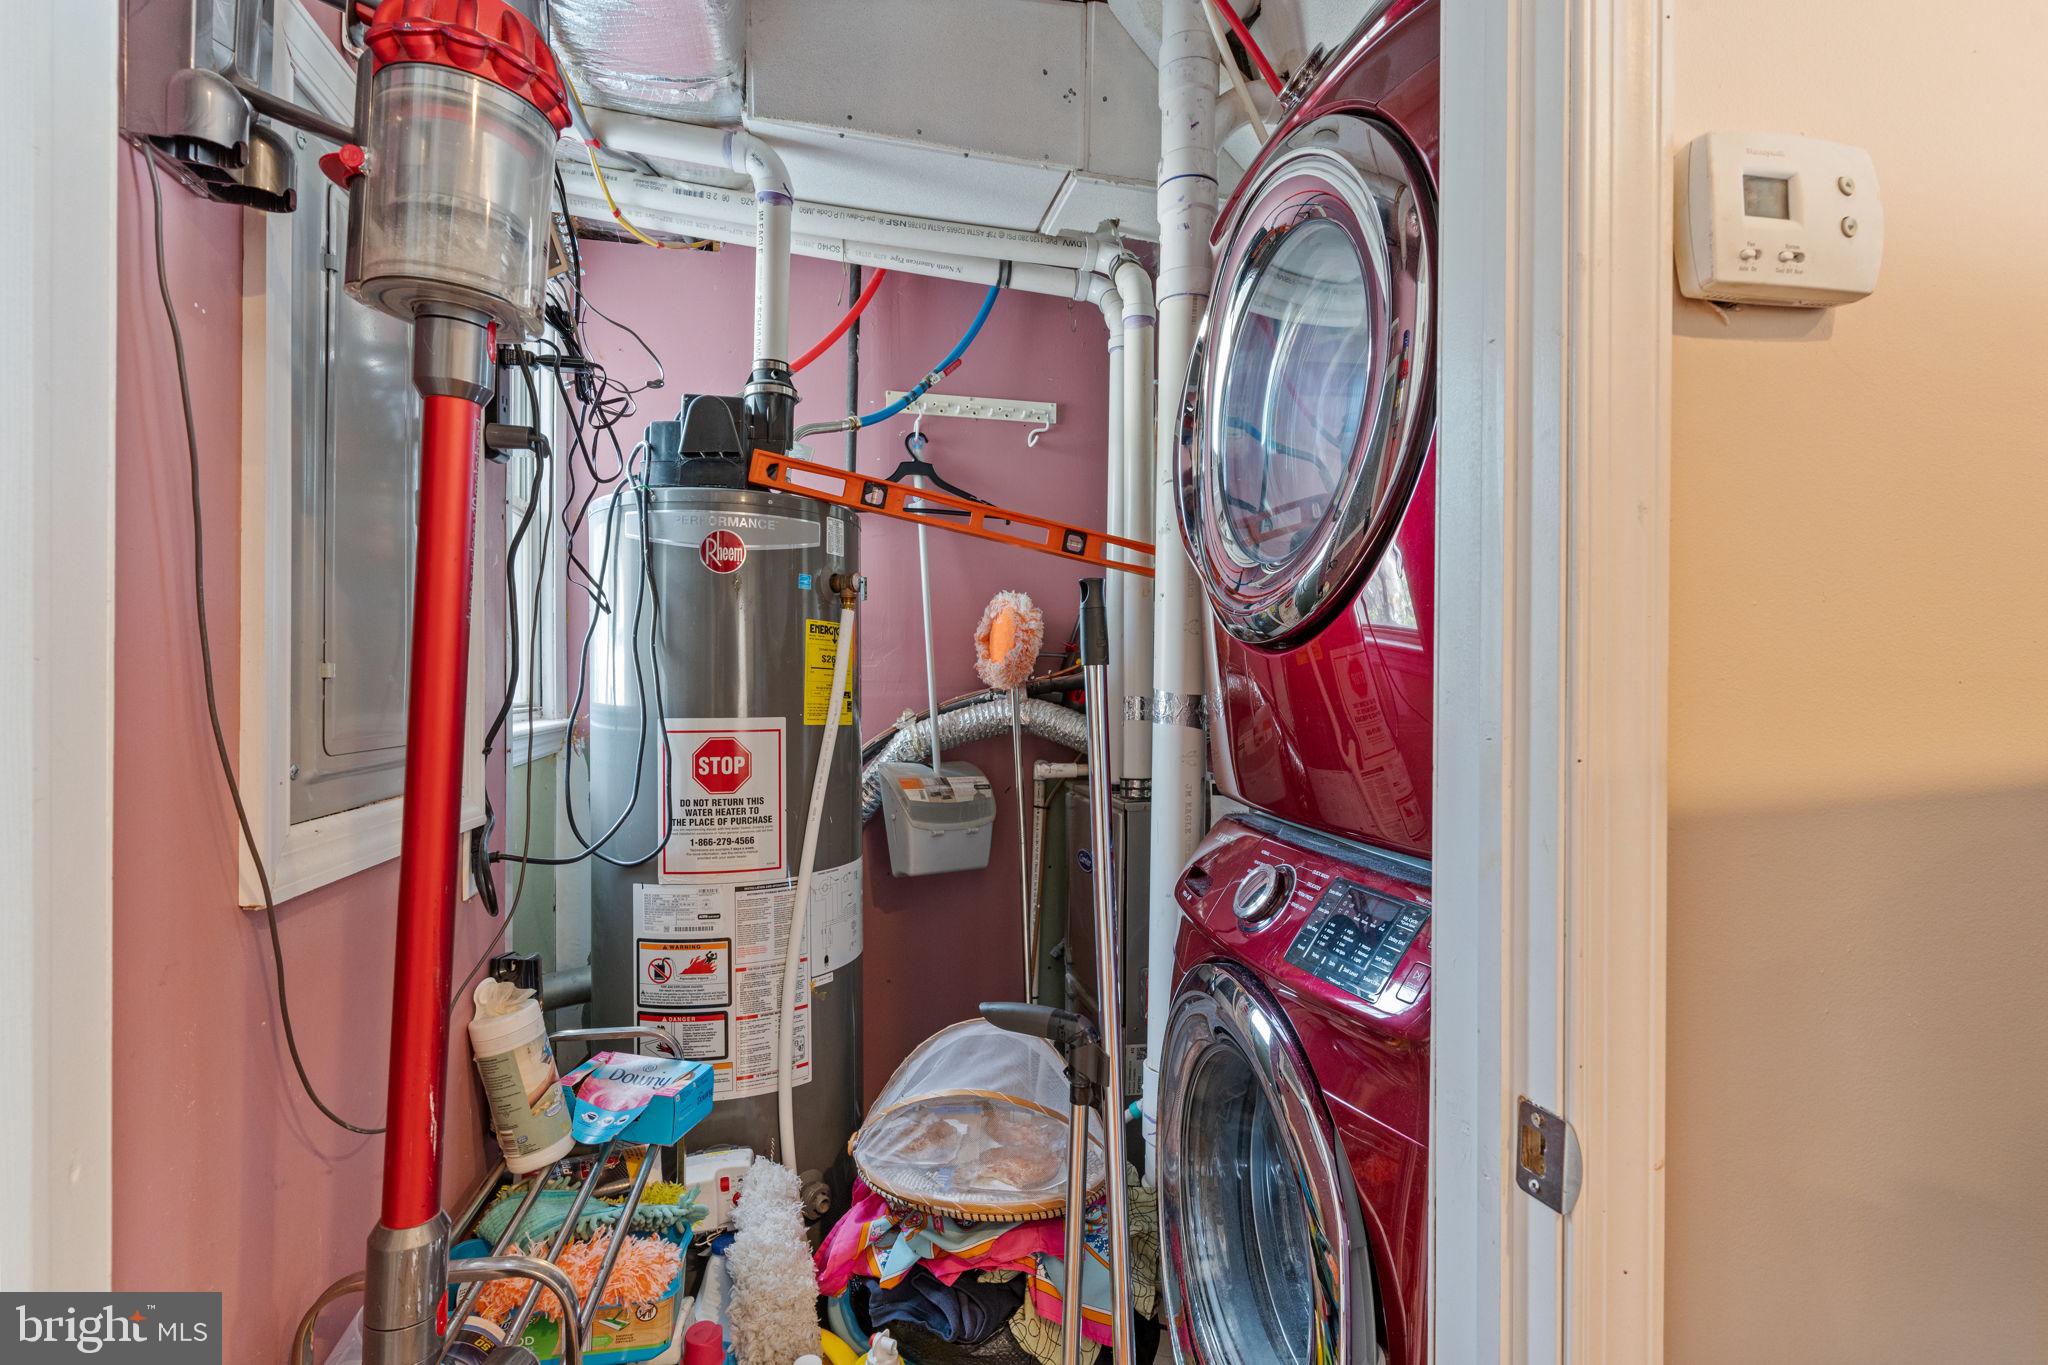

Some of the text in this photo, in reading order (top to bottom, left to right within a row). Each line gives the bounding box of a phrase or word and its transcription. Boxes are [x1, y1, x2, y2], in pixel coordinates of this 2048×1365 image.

[886, 218, 906, 228] NSF
[817, 242, 840, 253] SCH40
[674, 515, 776, 530] PERFORMANCE
[706, 531, 742, 567] Rheem
[698, 756, 746, 775] STOP
[680, 797, 764, 808] DO NOT RETURN THIS
[685, 806, 759, 816] WATER HEATER TO
[672, 816, 773, 826] THE PLACE OF PURCHASE
[1184, 802, 1192, 834] EAGLE
[690, 836, 754, 846] 1-866-279-4566
[608, 1068, 672, 1090] Downy
